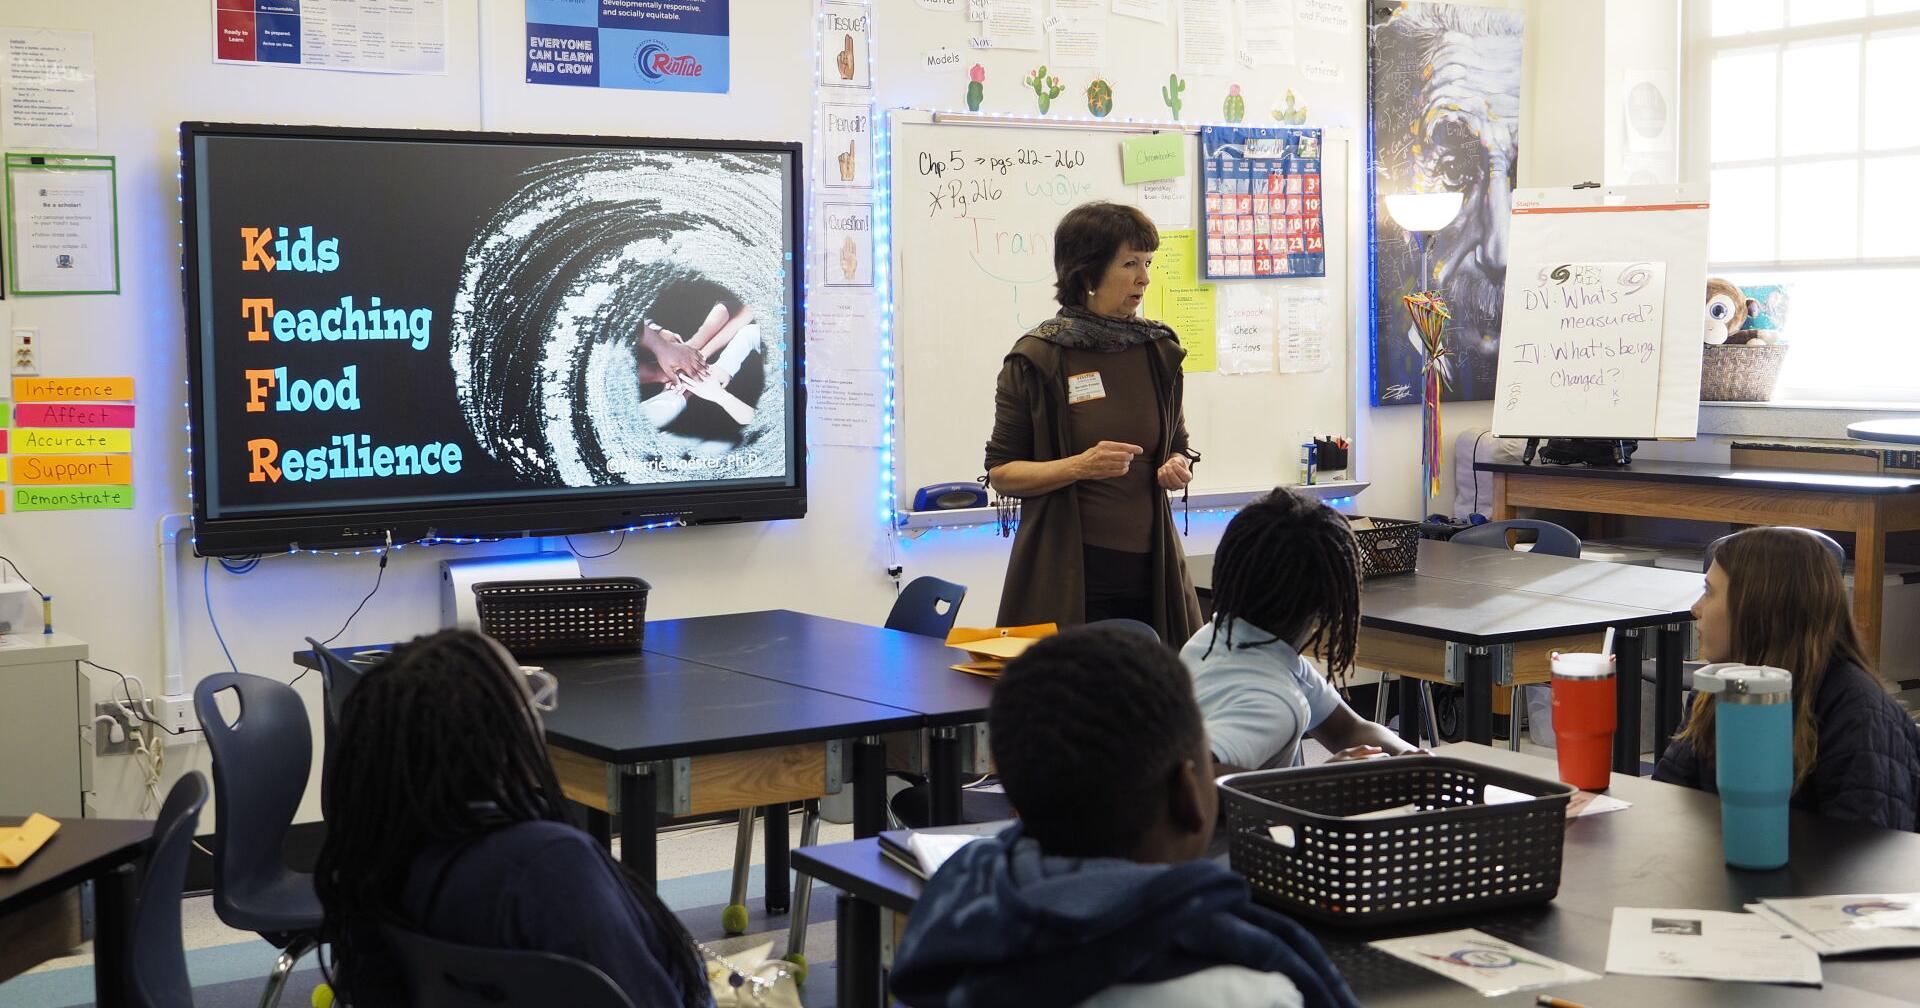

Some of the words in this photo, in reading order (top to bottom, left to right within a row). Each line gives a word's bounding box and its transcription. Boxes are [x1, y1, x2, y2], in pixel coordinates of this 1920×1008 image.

[618, 9, 645, 19] socially
[645, 12, 681, 20] equitable.
[663, 3, 701, 12] responsive,
[825, 13, 867, 33] Tissue?
[223, 28, 242, 36] Ready
[530, 36, 593, 51] EVERYONE
[972, 37, 993, 48] Nov.
[529, 49, 552, 61] CAN
[553, 51, 594, 63] LEARN
[927, 52, 960, 66] Models
[530, 62, 555, 74] AND
[558, 63, 593, 75] GROW
[828, 113, 867, 133] Pencil?
[918, 151, 950, 178] Chp.
[950, 149, 965, 171] 5
[990, 157, 1016, 175] pgs.
[948, 179, 971, 218] Pg.
[971, 178, 1003, 203] 216
[1305, 199, 1318, 210] 10
[1515, 200, 1541, 208] Staples
[1288, 218, 1302, 230] 16
[1304, 217, 1317, 230] 17
[953, 216, 1050, 256] Tran
[1256, 239, 1270, 251] 21
[1273, 238, 1287, 250] 22
[1289, 237, 1302, 250] 23
[1307, 237, 1322, 250] 24
[240, 225, 341, 274] Kids
[1256, 259, 1271, 271] 28
[1273, 259, 1287, 271] 29
[242, 295, 433, 351] Teaching
[1560, 304, 1654, 331] measured?
[1234, 325, 1259, 336] Check
[1231, 343, 1262, 354] Fridays
[1549, 337, 1617, 361] What's
[1619, 337, 1656, 364] being
[26, 380, 113, 396] Inference
[245, 364, 361, 412] Flood
[42, 405, 110, 424] Affect
[26, 431, 107, 447] Accurate
[247, 433, 463, 484] Resilience
[23, 455, 113, 481] Support
[17, 489, 121, 505] Demonstrate
